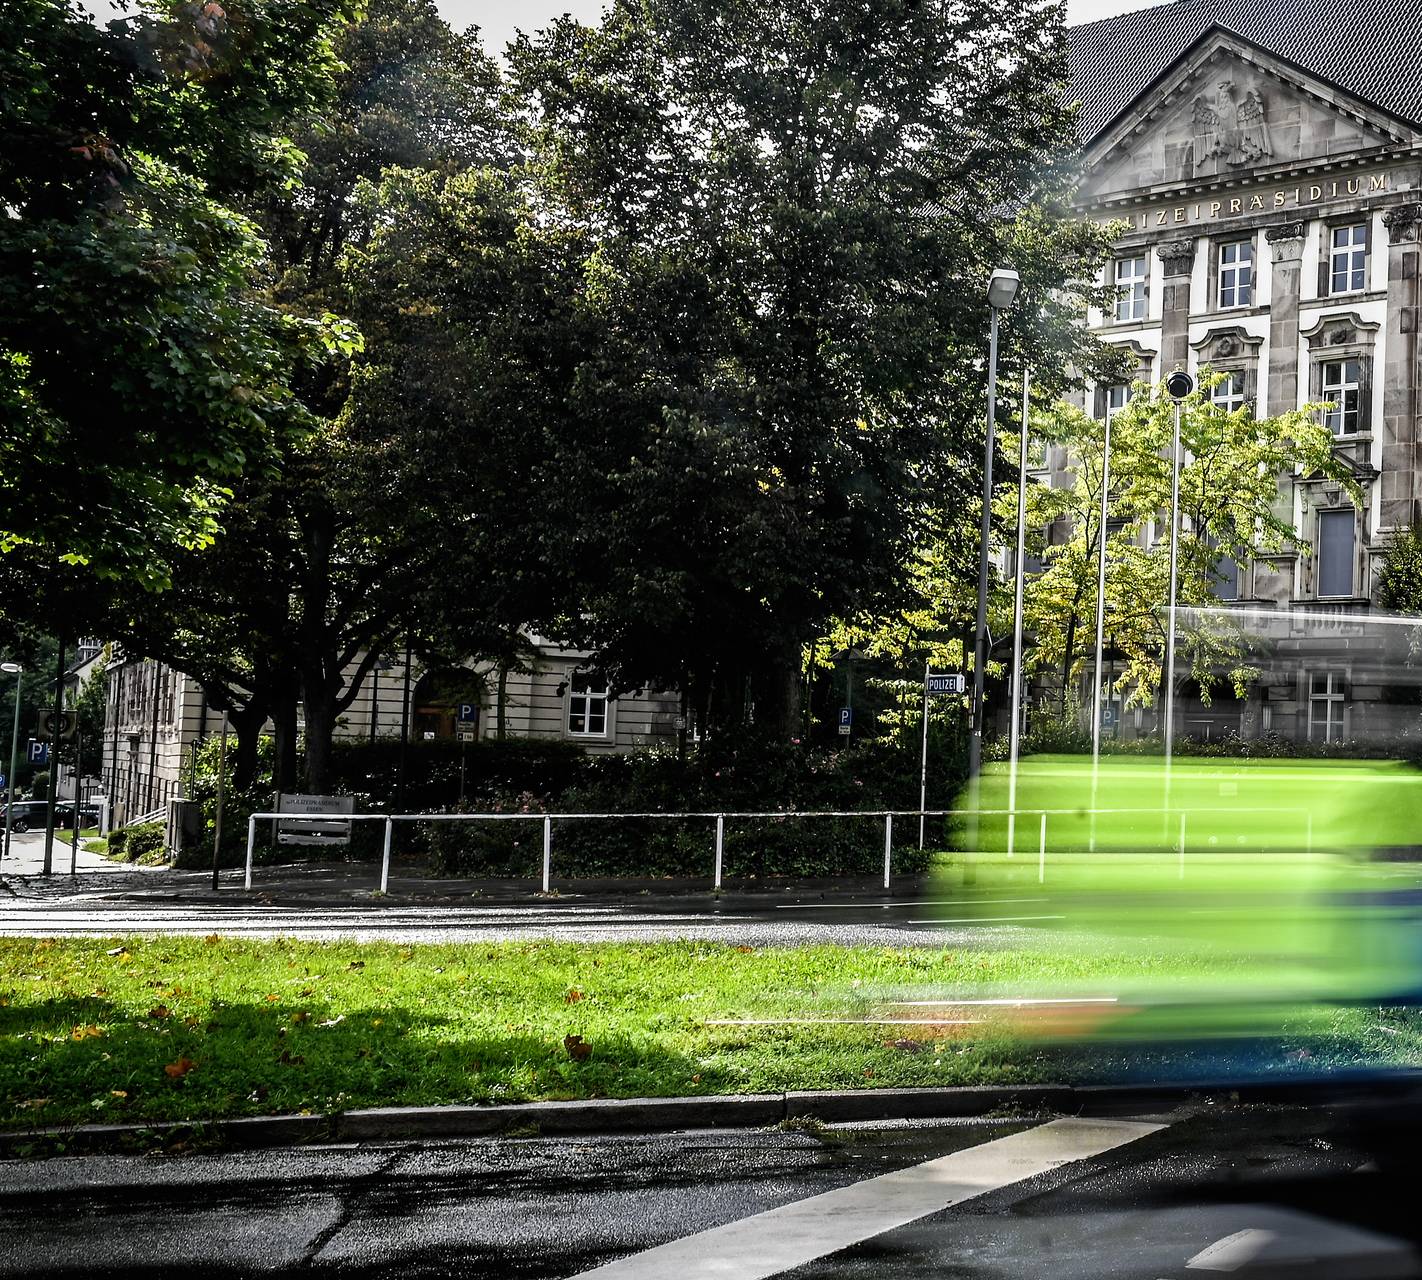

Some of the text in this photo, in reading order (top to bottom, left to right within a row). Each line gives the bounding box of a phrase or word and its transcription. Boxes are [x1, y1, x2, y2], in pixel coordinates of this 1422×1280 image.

[929, 679, 956, 690] POLIZEI
[462, 704, 471, 719] P
[841, 710, 849, 723] P
[1103, 711, 1112, 724] P
[32, 743, 43, 760] P
